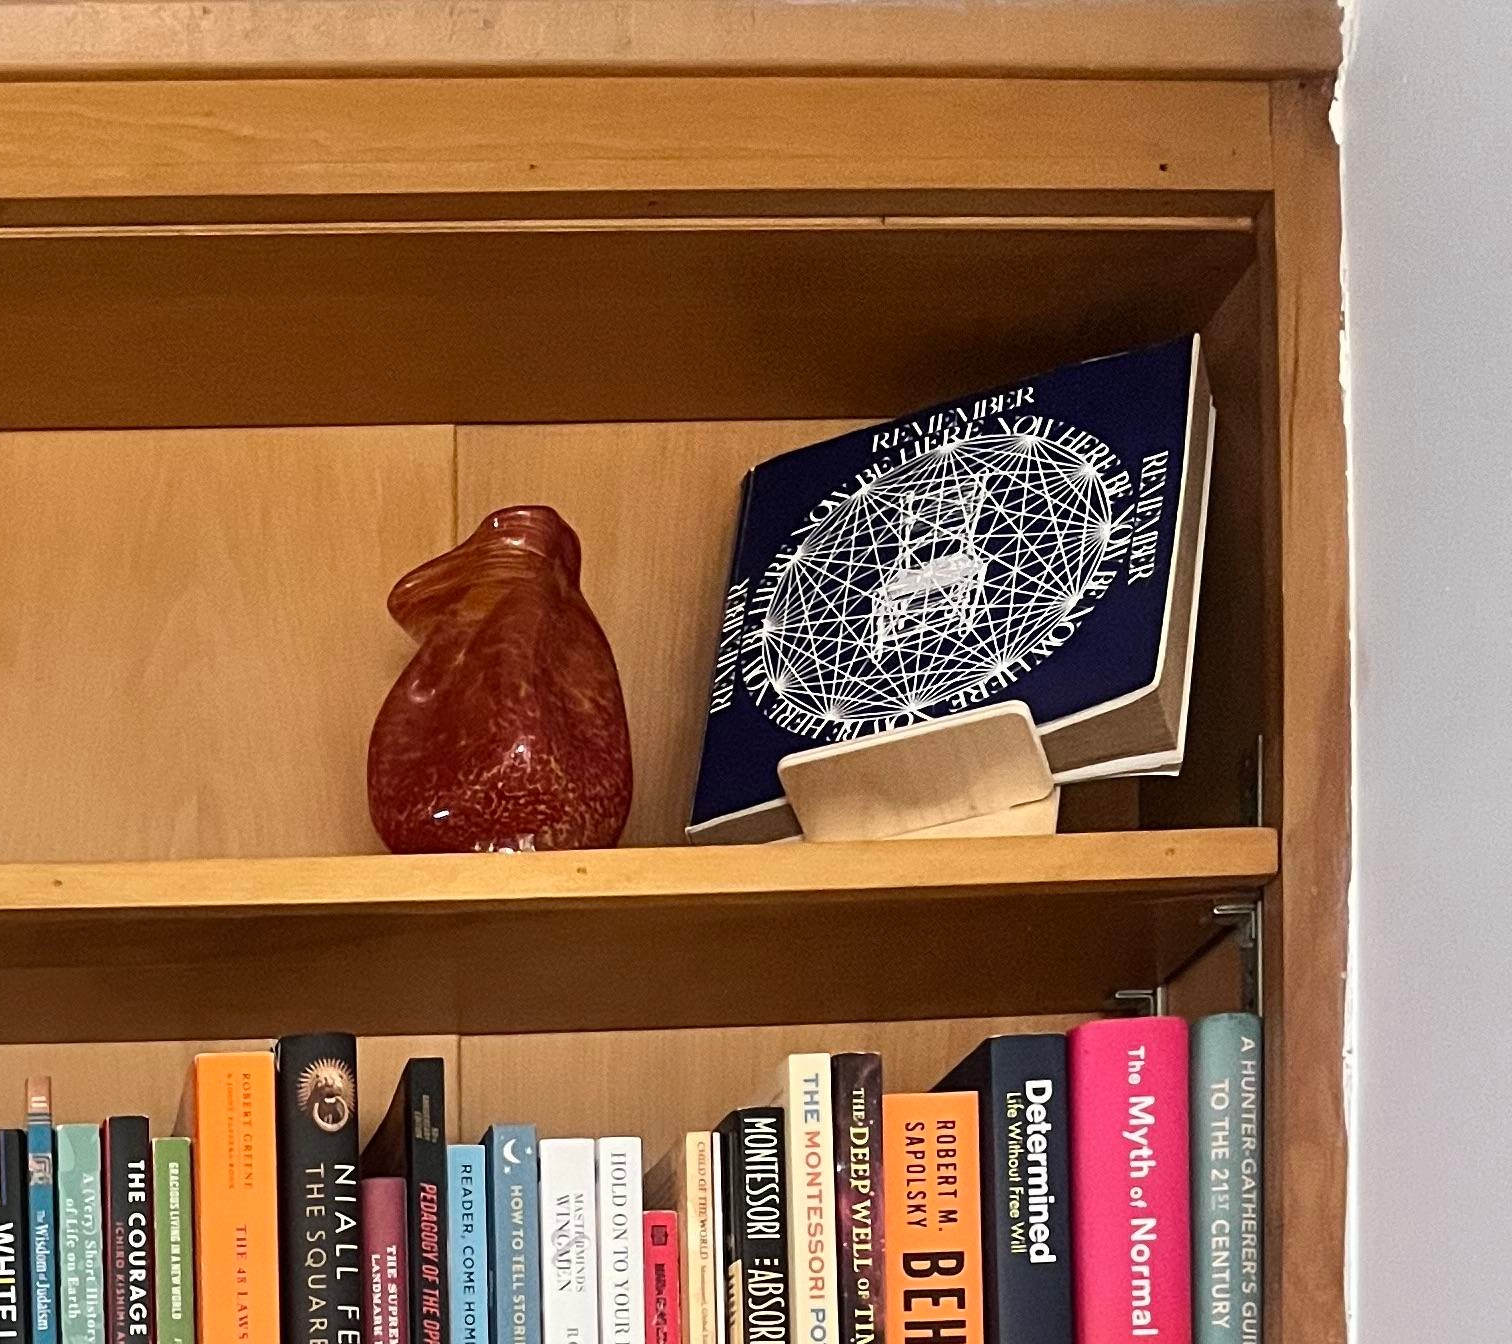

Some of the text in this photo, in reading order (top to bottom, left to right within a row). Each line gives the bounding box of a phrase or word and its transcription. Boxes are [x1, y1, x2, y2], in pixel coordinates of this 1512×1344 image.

[127, 1161, 145, 1203] THE
[334, 1163, 357, 1280] NIALL
[420, 1183, 439, 1263] PEDAGOGY
[1006, 1093, 1027, 1253] Life Without Free Will
[1024, 1080, 1057, 1263] Determined
[1122, 1046, 1158, 1337] The Myth of Normal
[128, 1212, 147, 1336] COURAGE
[423, 1266, 439, 1283] OF
[423, 1287, 440, 1316] THE
